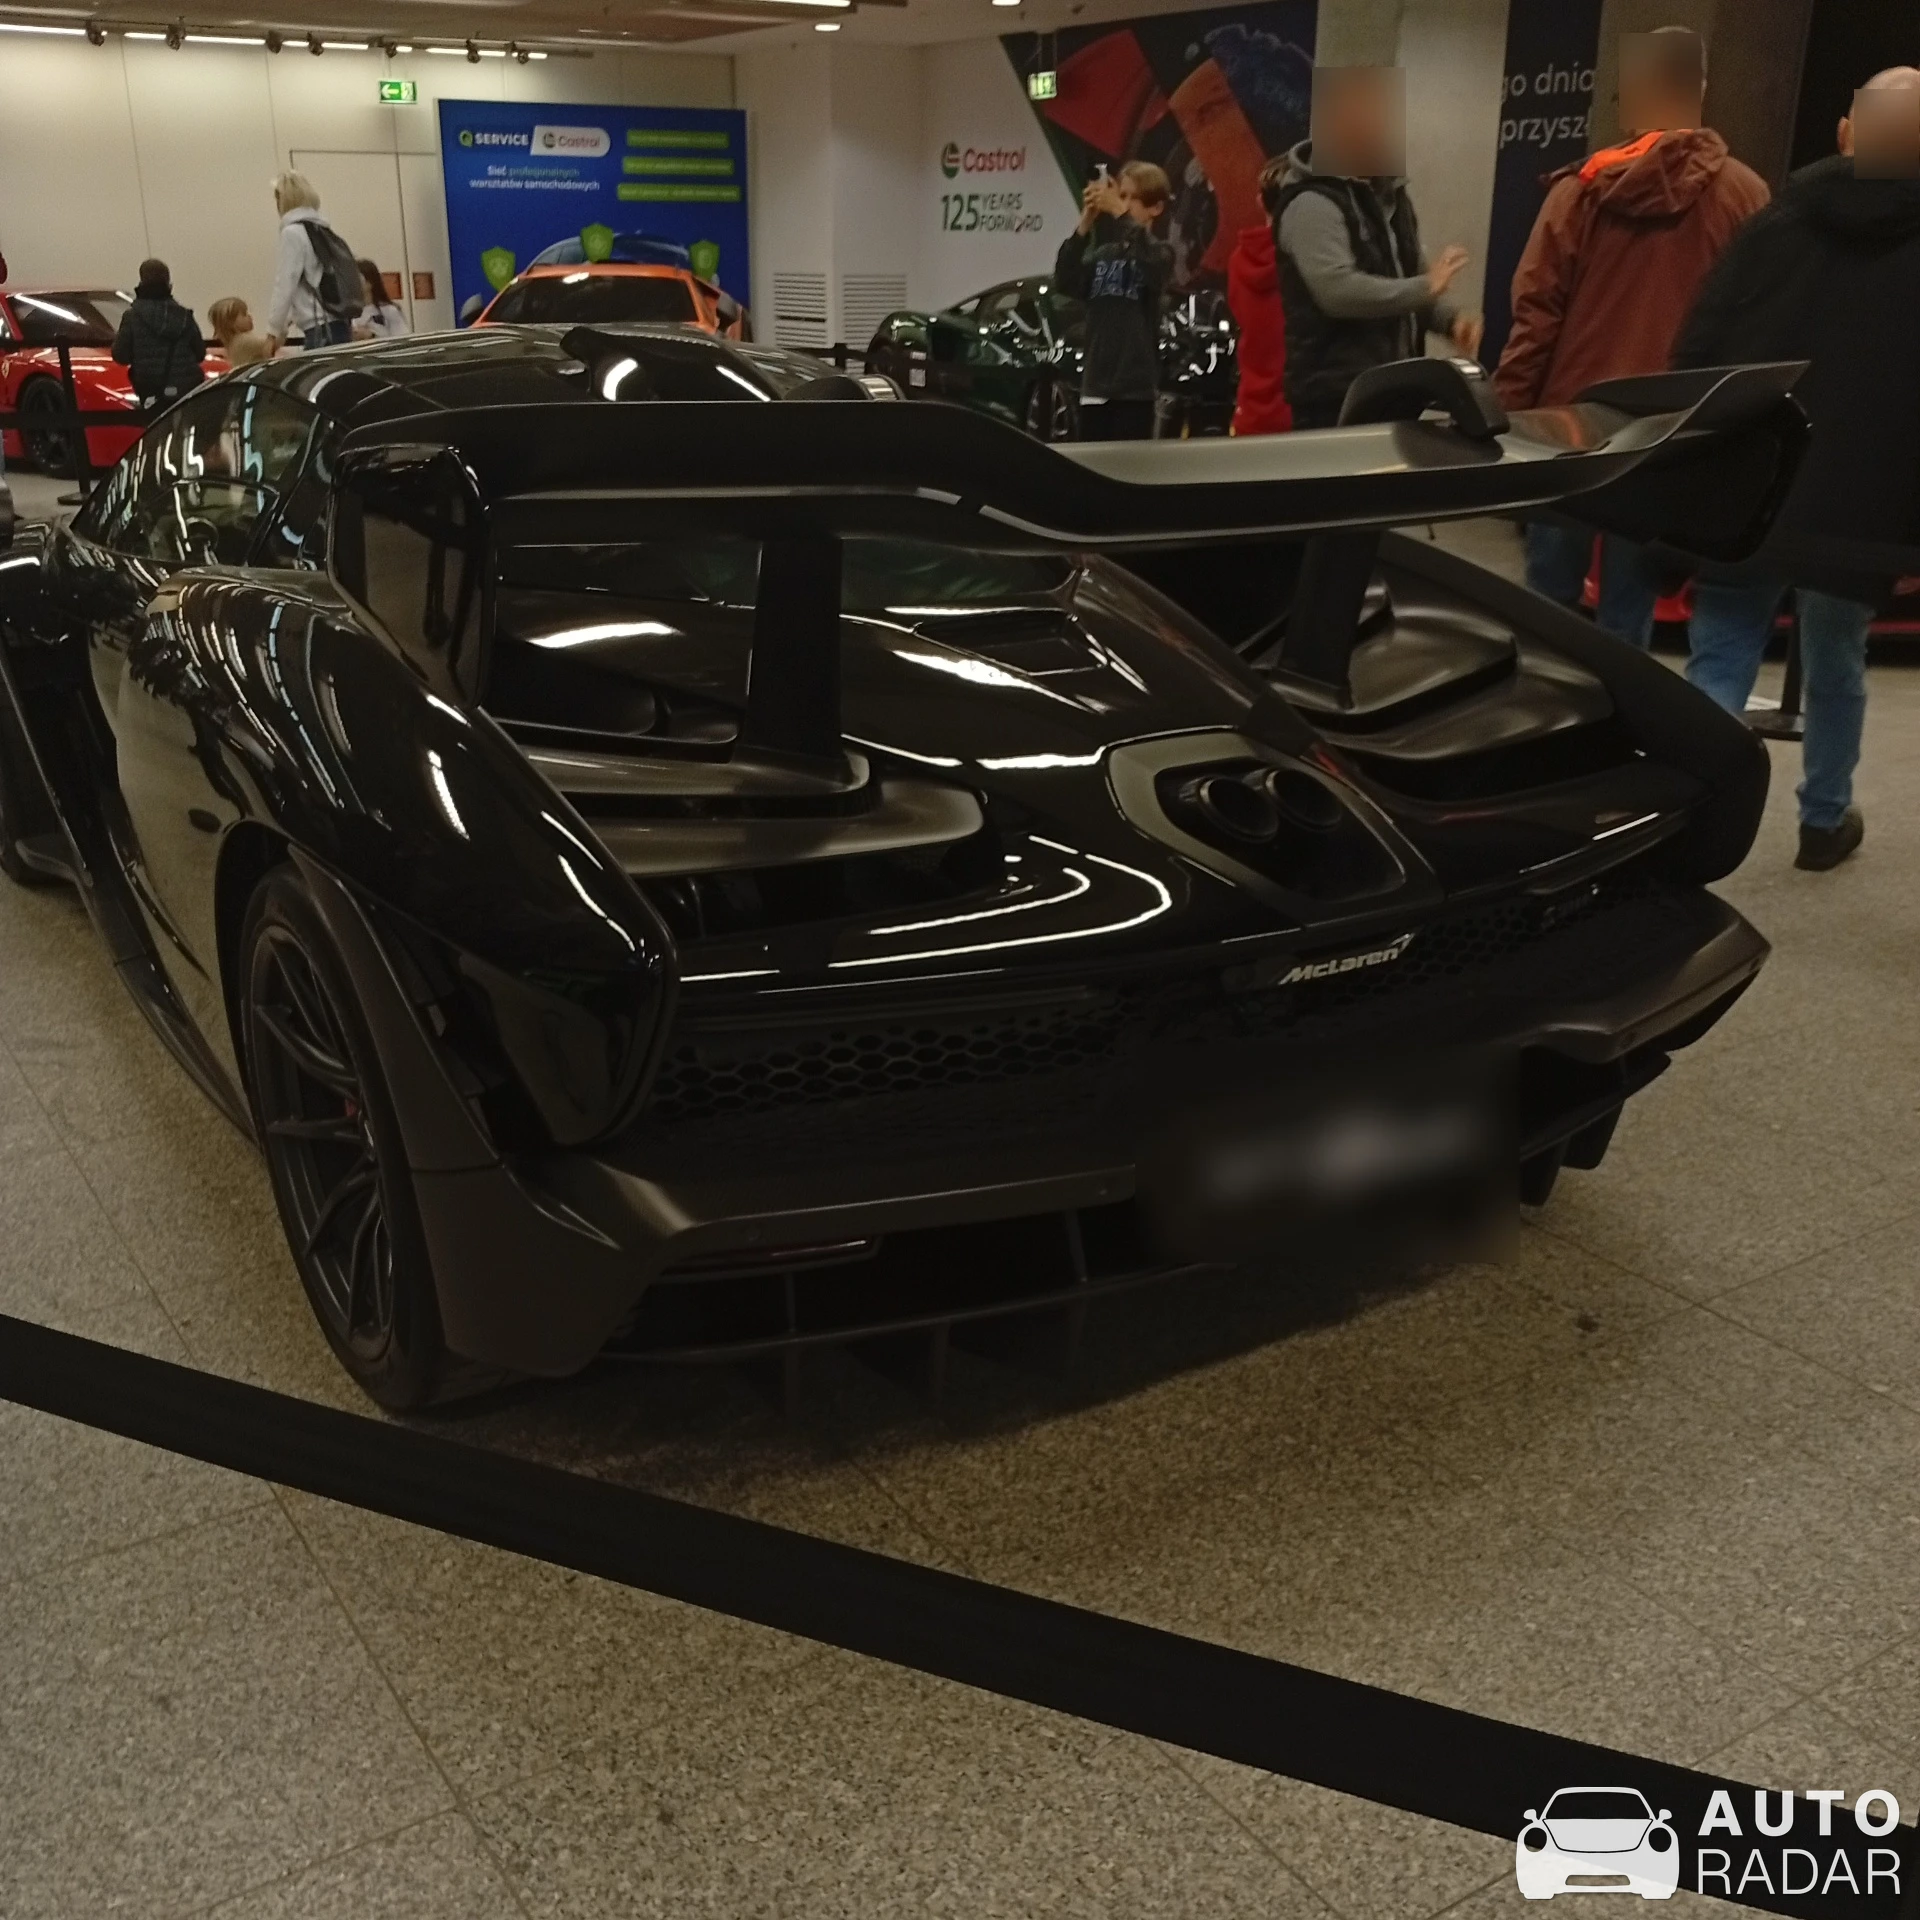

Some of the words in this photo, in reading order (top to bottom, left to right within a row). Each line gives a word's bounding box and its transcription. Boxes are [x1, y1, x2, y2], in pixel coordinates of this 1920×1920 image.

[474, 132, 529, 146] SERVICE
[558, 135, 601, 149] Castrol
[963, 146, 1026, 173] Castrol
[524, 179, 601, 192] samochodowych
[941, 193, 980, 231] 125
[1278, 940, 1404, 986] McLaren
